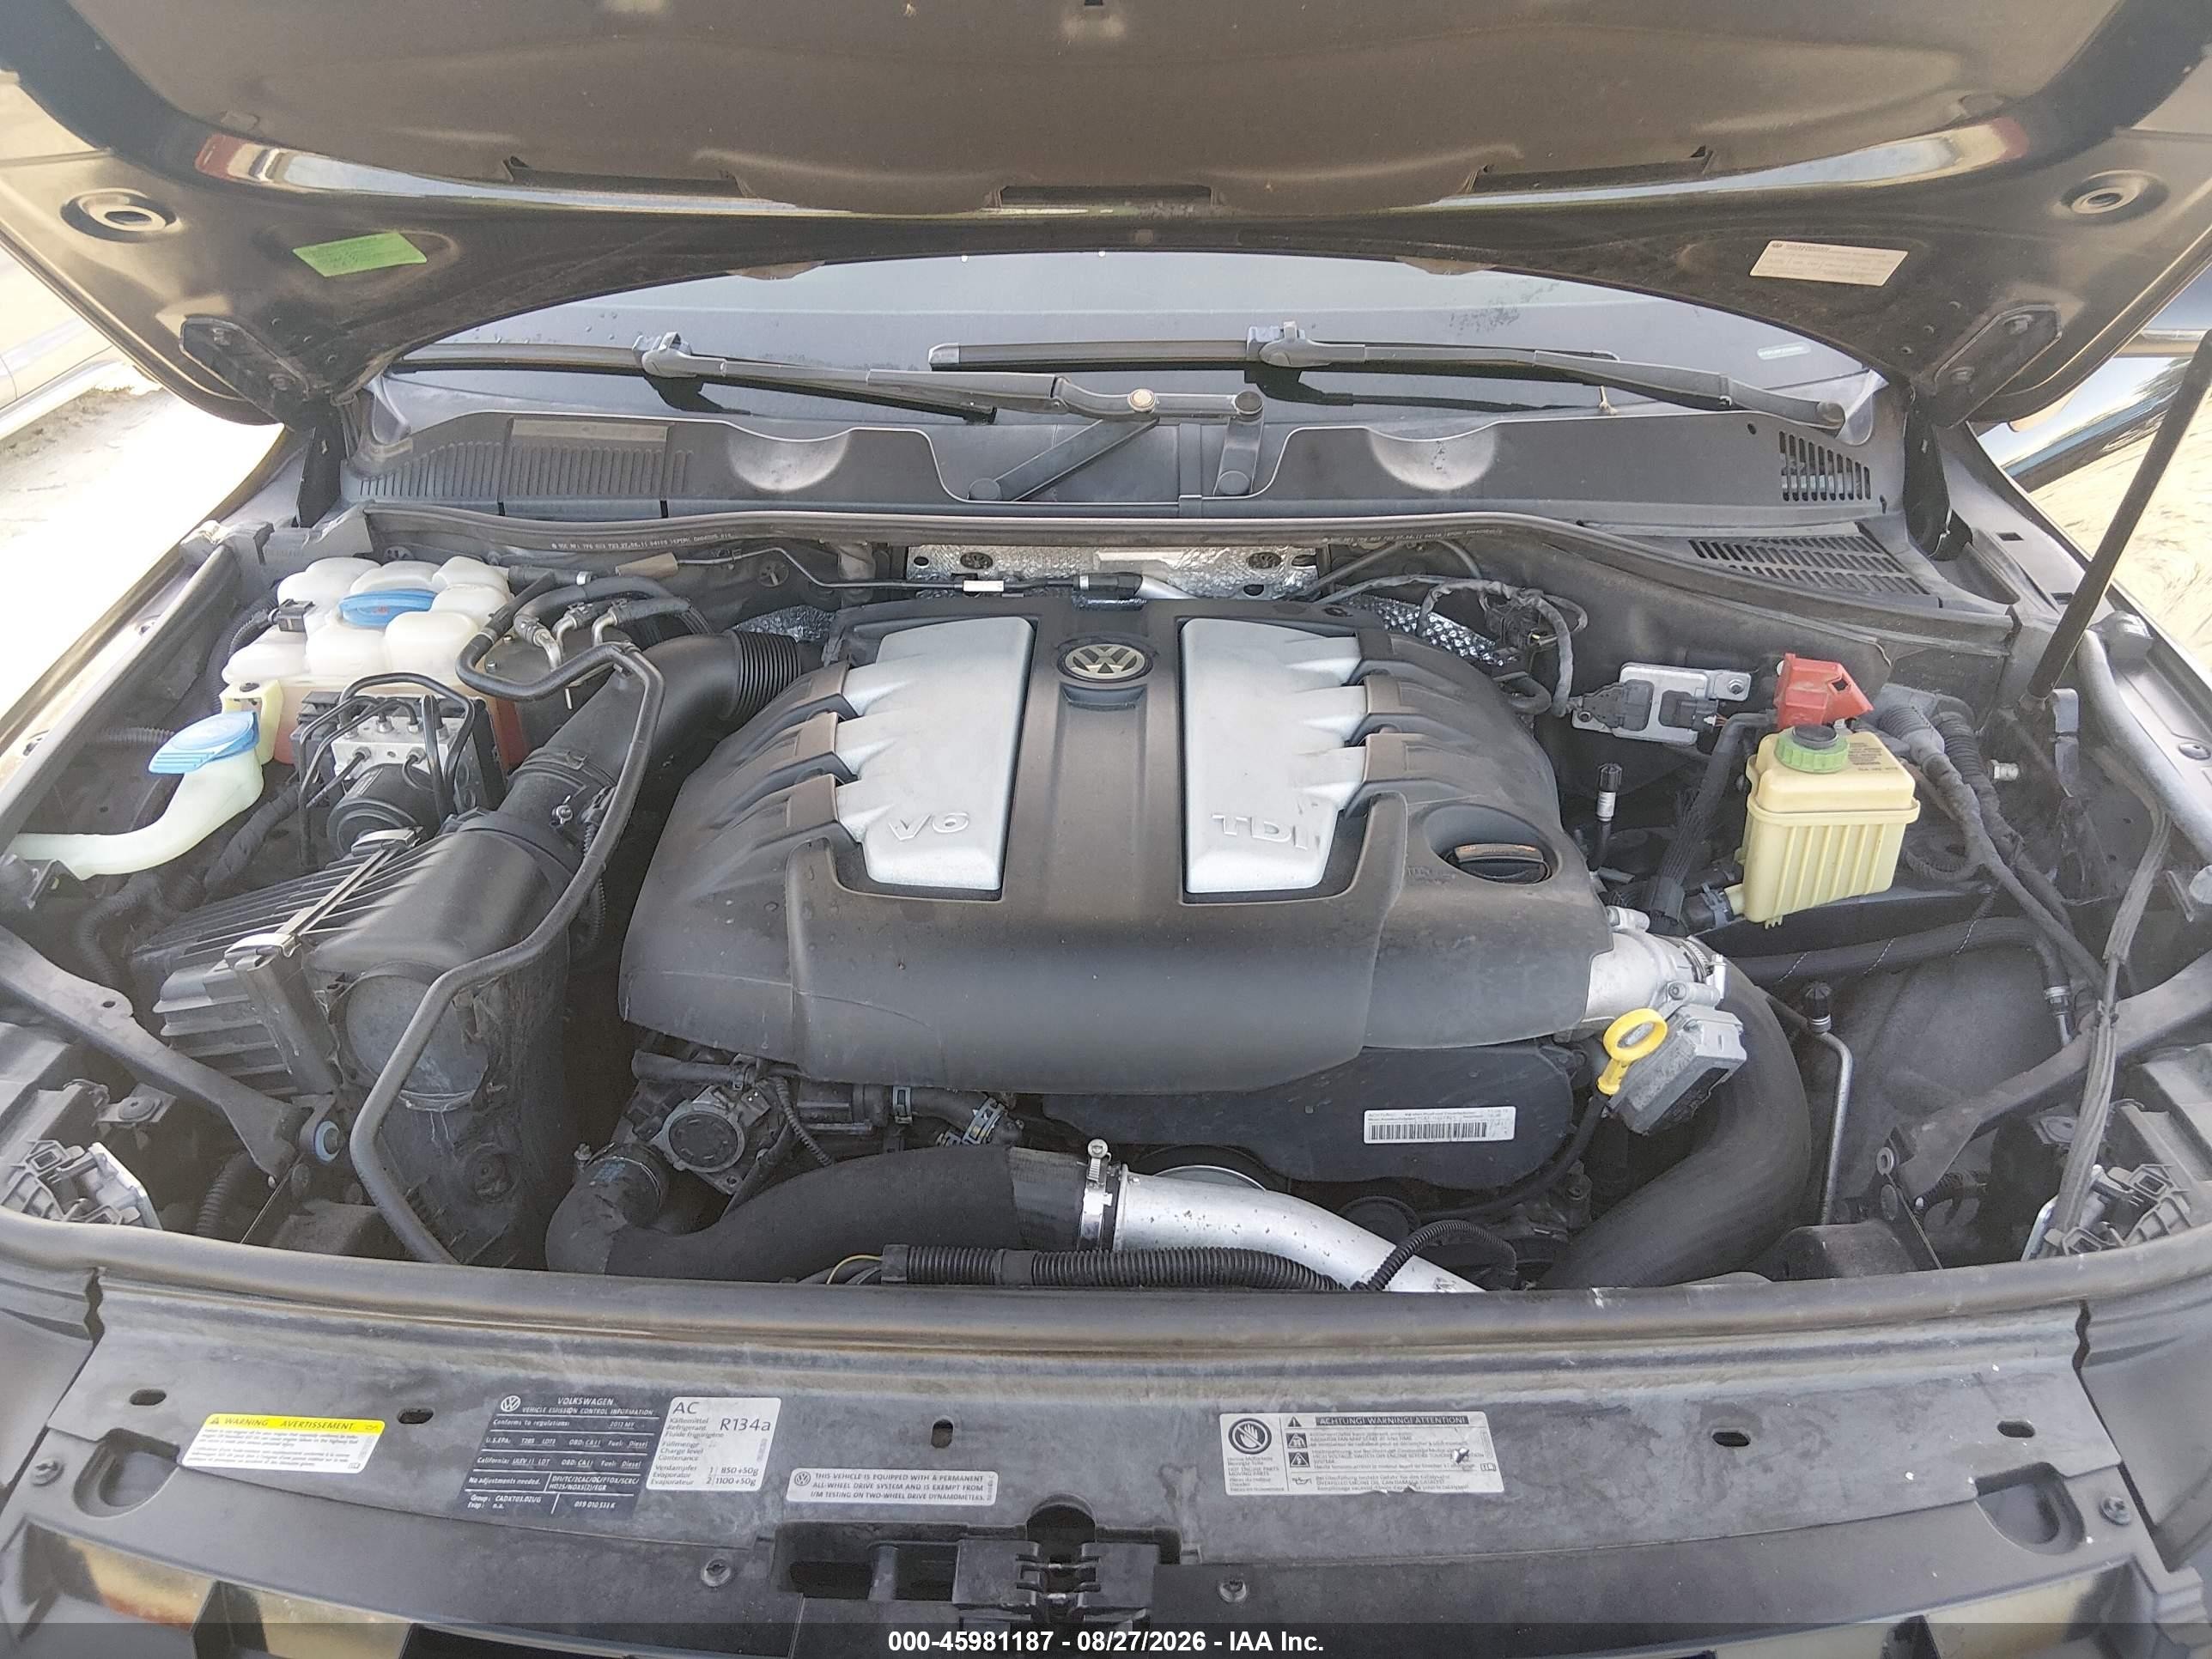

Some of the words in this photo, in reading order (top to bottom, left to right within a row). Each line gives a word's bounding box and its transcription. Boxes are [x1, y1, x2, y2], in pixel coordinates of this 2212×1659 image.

[888, 811, 969, 842] V6
[1211, 812, 1310, 850] TDI
[557, 1397, 614, 1406] VOLKSWAGEN
[672, 1401, 700, 1414] AC
[224, 1417, 269, 1426] WARNING
[280, 1420, 355, 1430] AVERTISSEMENT
[720, 1418, 771, 1431] R134a
[1414, 1416, 1466, 1425] ATTENTION!
